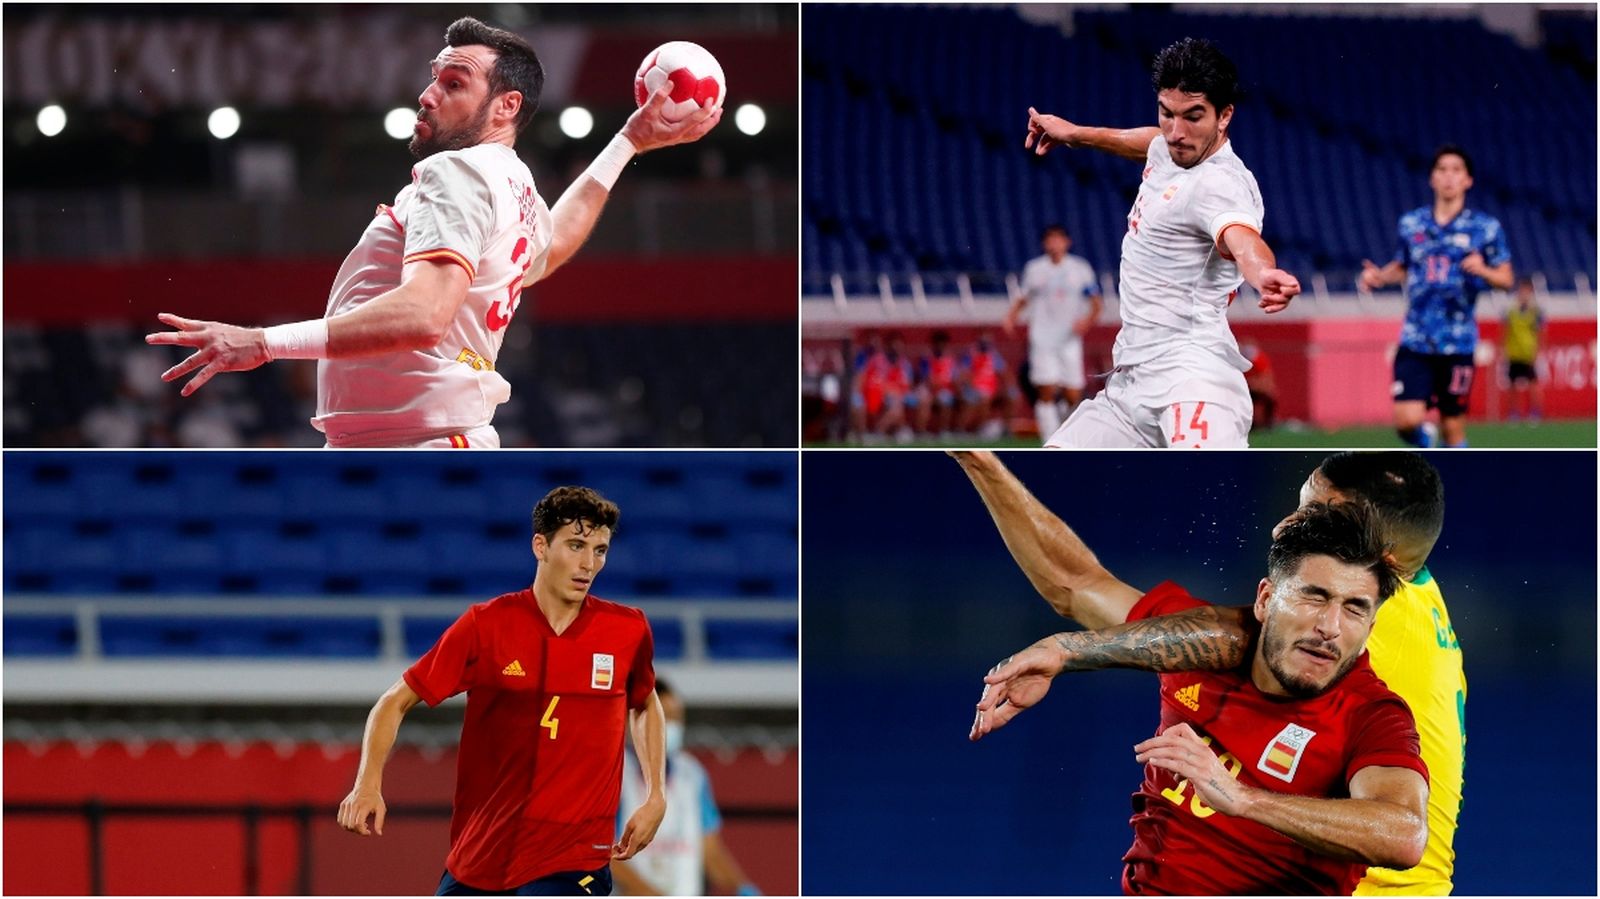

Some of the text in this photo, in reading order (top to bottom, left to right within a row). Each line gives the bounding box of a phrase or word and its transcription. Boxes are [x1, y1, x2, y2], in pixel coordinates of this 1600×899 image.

[1171, 401, 1208, 443] 14
[540, 695, 560, 740] 4
[1174, 690, 1200, 712] adidas
